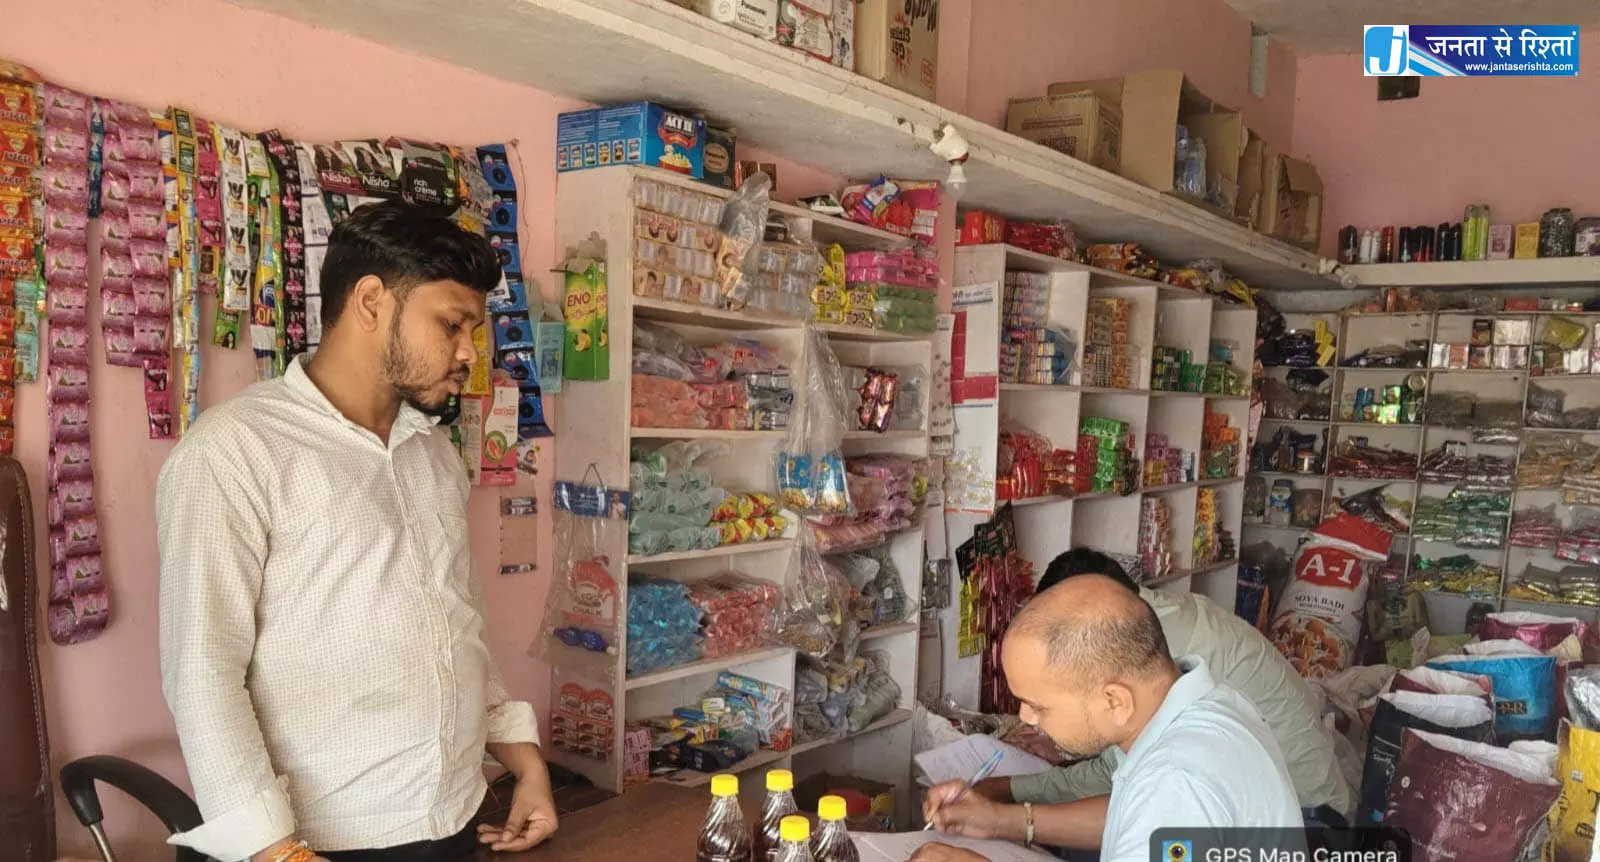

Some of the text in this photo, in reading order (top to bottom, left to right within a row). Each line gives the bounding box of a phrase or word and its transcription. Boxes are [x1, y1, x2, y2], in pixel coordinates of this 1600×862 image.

[321, 171, 352, 185] Nisha
[362, 174, 390, 188] Nisha
[414, 179, 428, 187] rich
[567, 292, 591, 307] ENO
[1301, 553, 1356, 585] A-1
